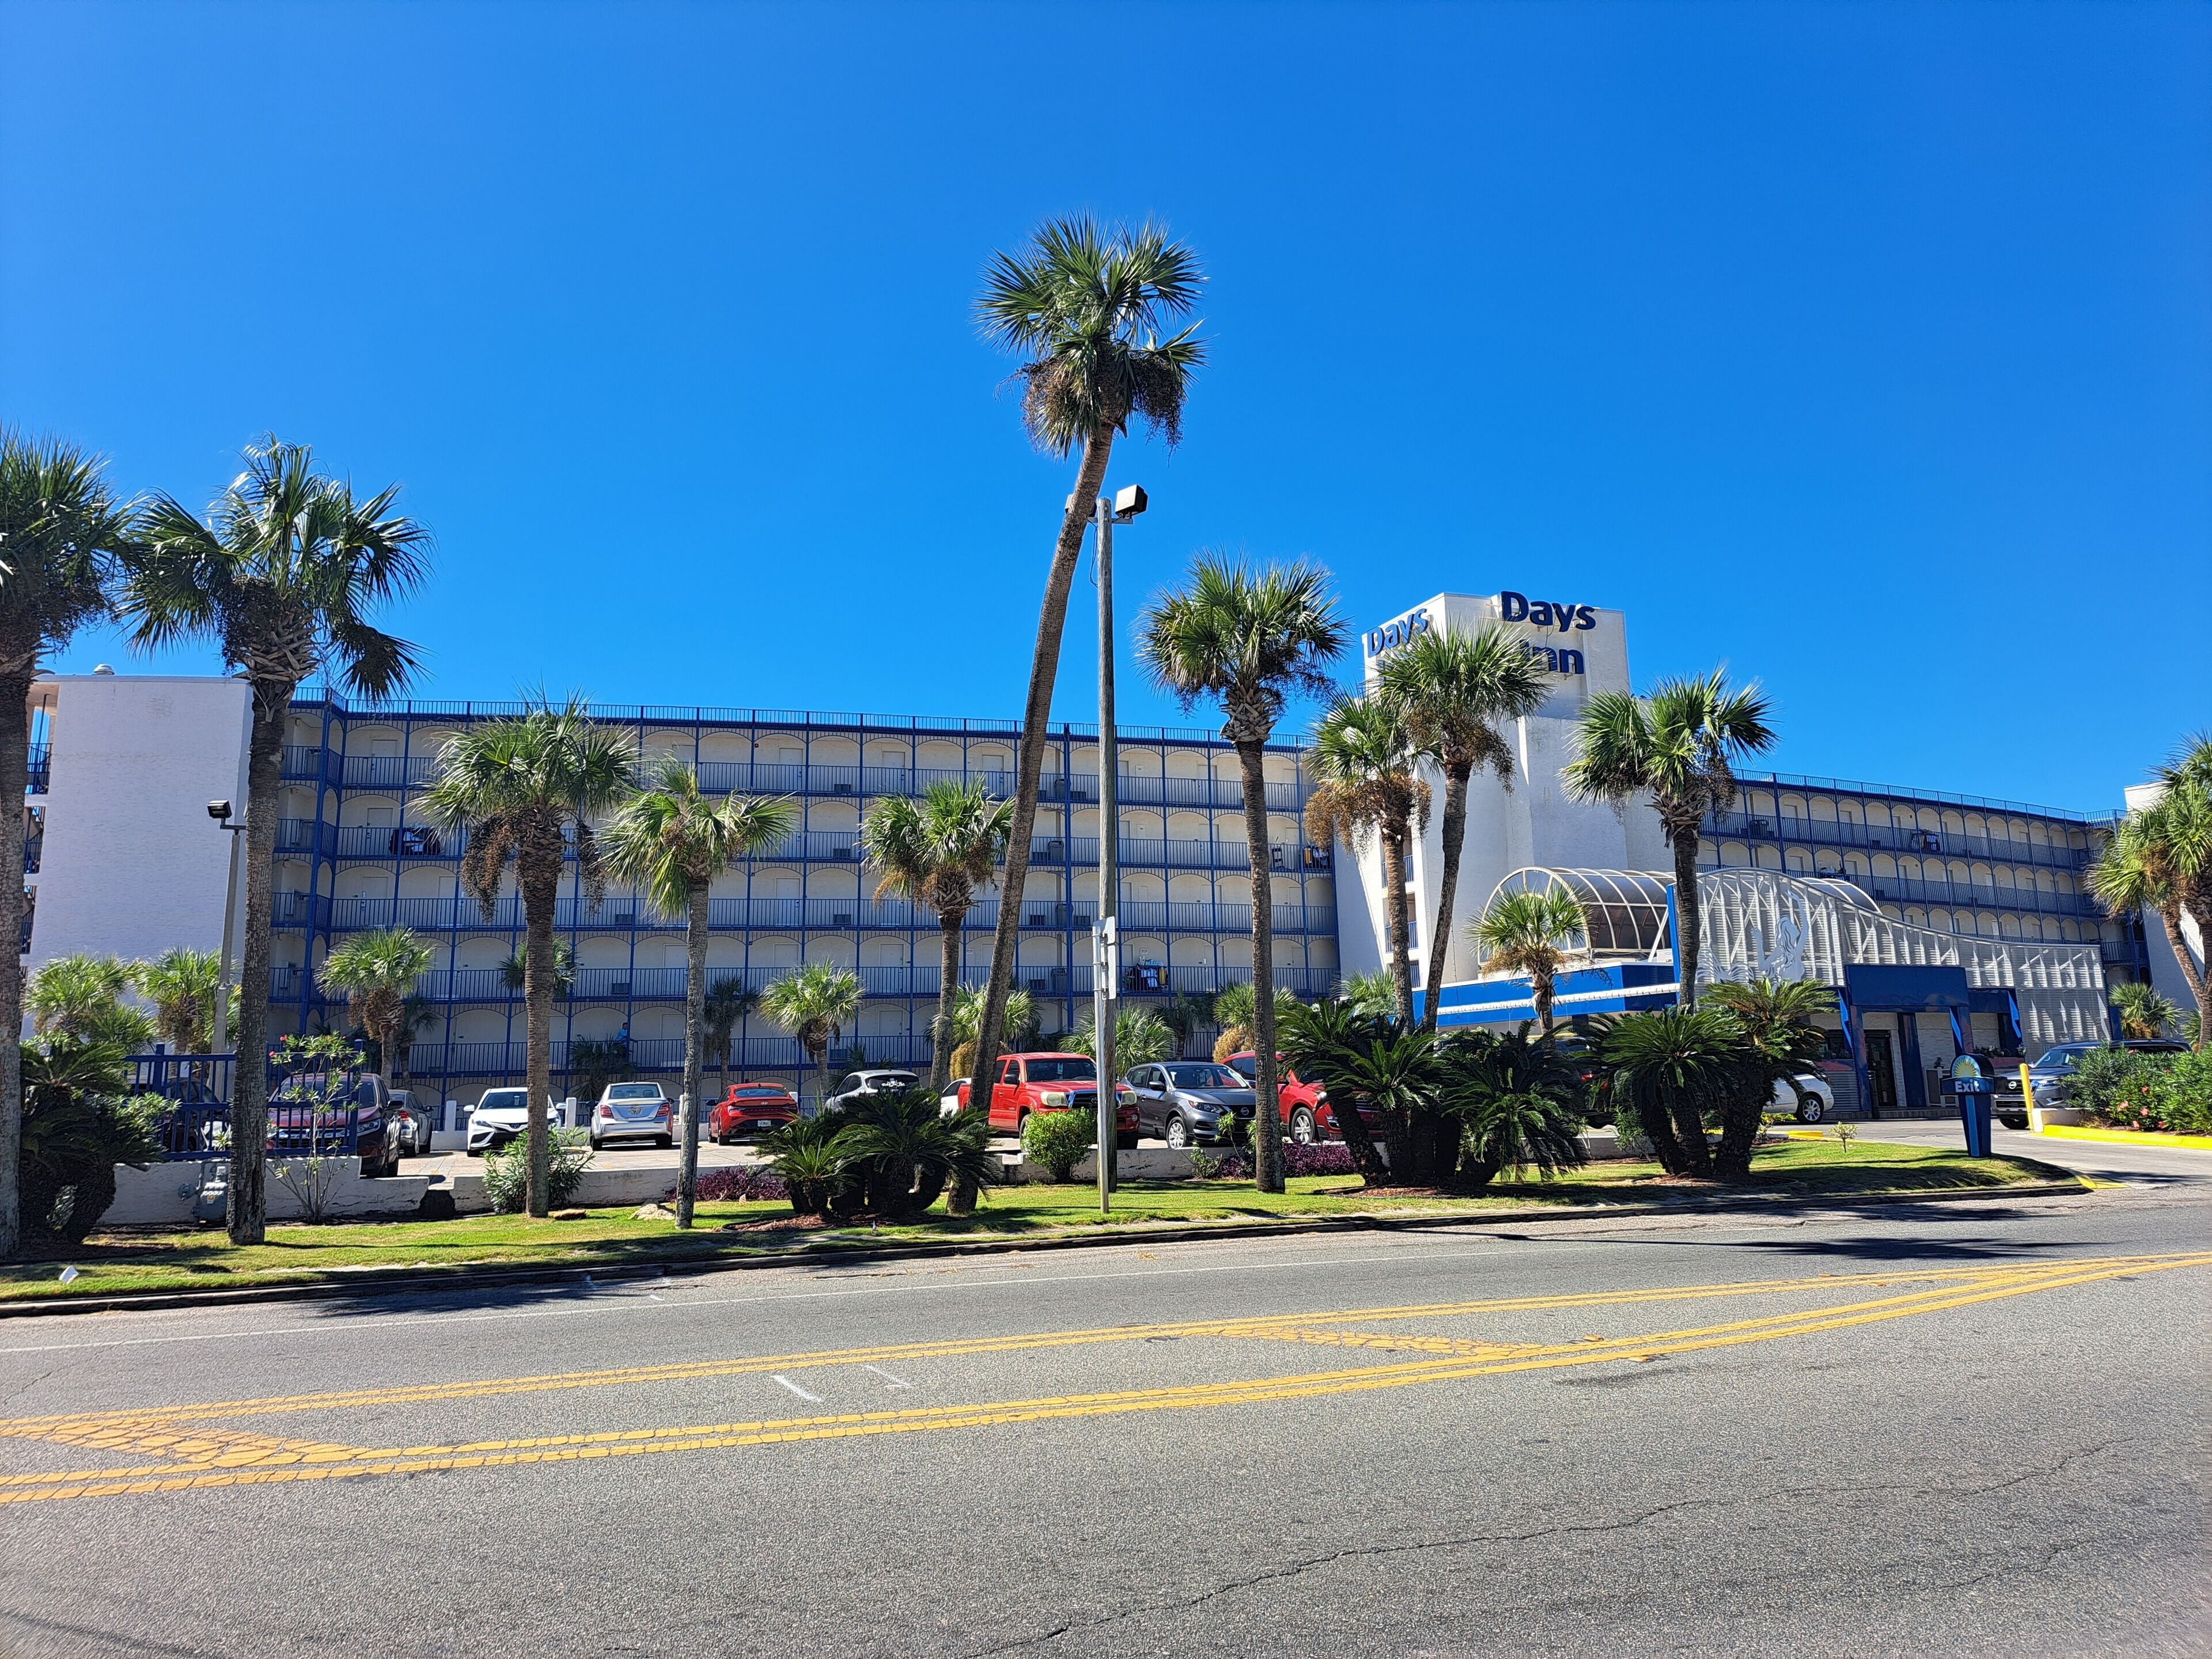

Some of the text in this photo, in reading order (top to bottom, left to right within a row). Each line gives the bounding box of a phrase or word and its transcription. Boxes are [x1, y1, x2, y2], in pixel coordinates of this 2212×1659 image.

[1501, 591, 1596, 632] Days
[1367, 608, 1429, 658] Days
[1955, 1079, 1980, 1093] Exit
